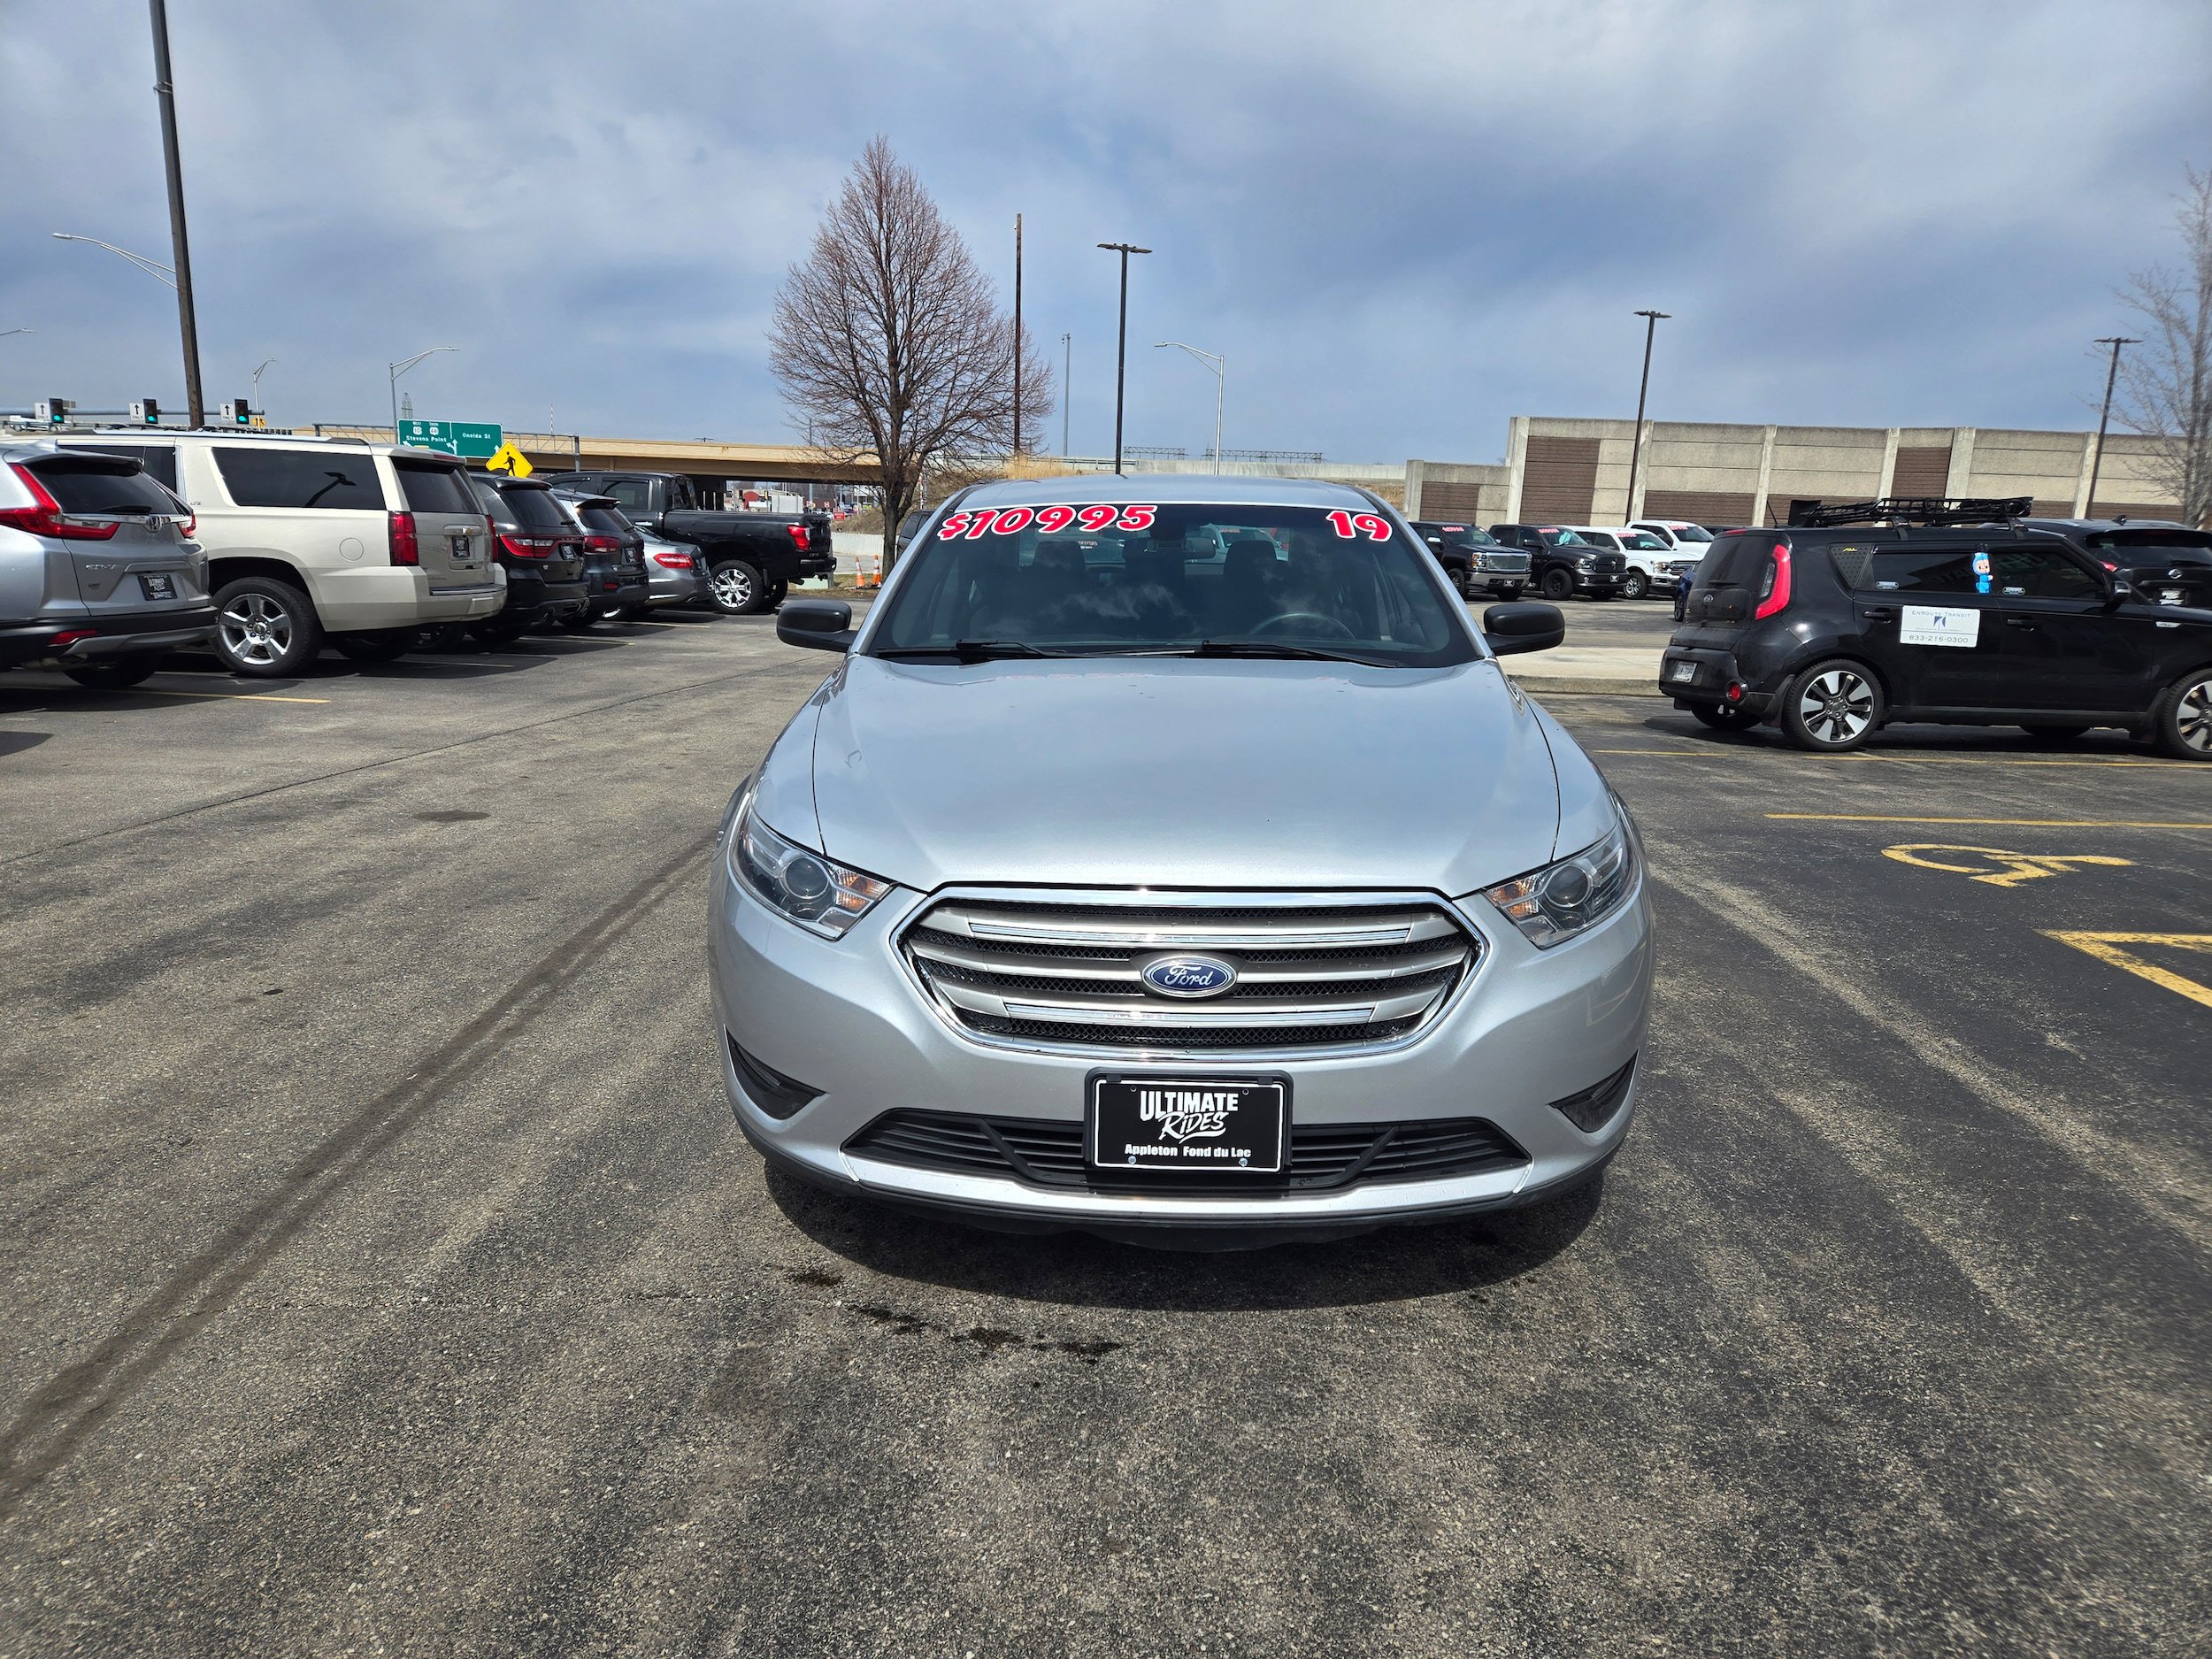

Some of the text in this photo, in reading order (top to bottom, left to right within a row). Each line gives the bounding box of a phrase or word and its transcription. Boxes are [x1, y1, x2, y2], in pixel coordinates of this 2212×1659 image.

[937, 504, 1158, 541] $10995
[1325, 510, 1393, 542] 19
[1909, 634, 1969, 643] 833-216-0300
[1164, 965, 1213, 986] Ford
[1140, 1090, 1239, 1122] ULTIMATE
[1125, 1144, 1252, 1158] Appleton Fond du Lac
